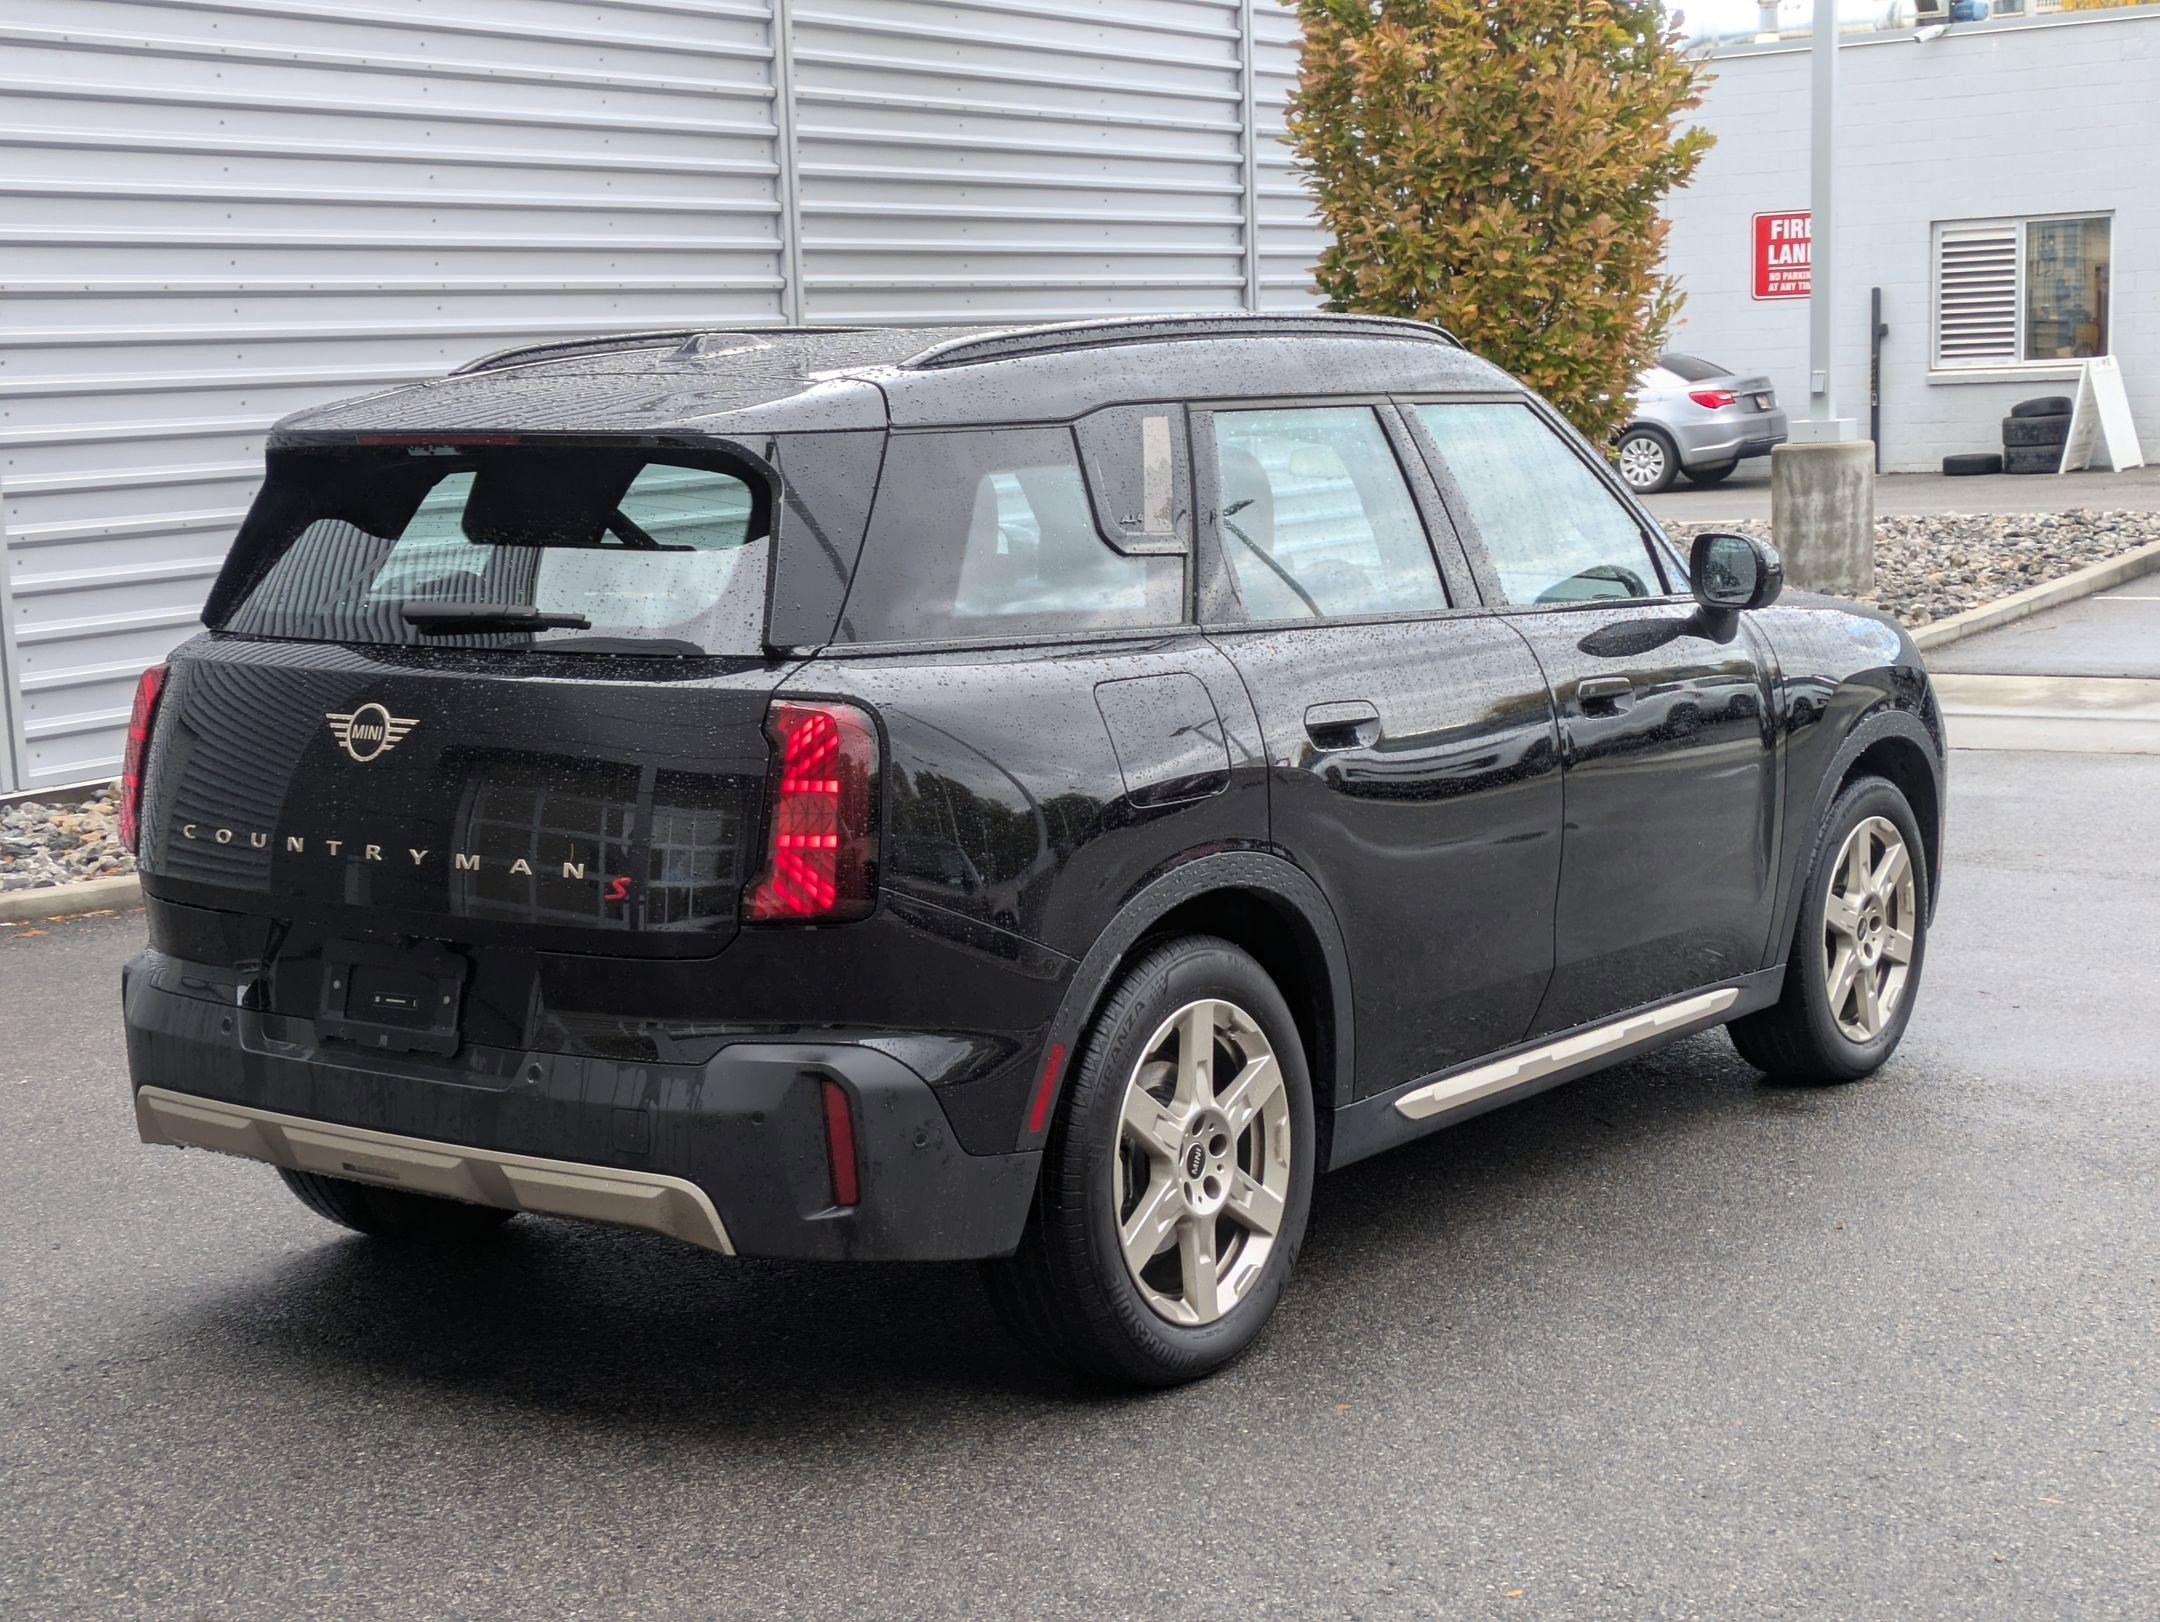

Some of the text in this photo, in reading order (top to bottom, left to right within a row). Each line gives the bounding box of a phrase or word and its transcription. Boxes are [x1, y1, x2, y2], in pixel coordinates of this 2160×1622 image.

[1769, 272, 1781, 281] NO
[1768, 283, 1779, 291] AT
[1779, 282, 1796, 291] ANY
[351, 724, 384, 741] MINI
[183, 824, 632, 901] COUNTRYMAN S
[1191, 1147, 1203, 1175] MINI
